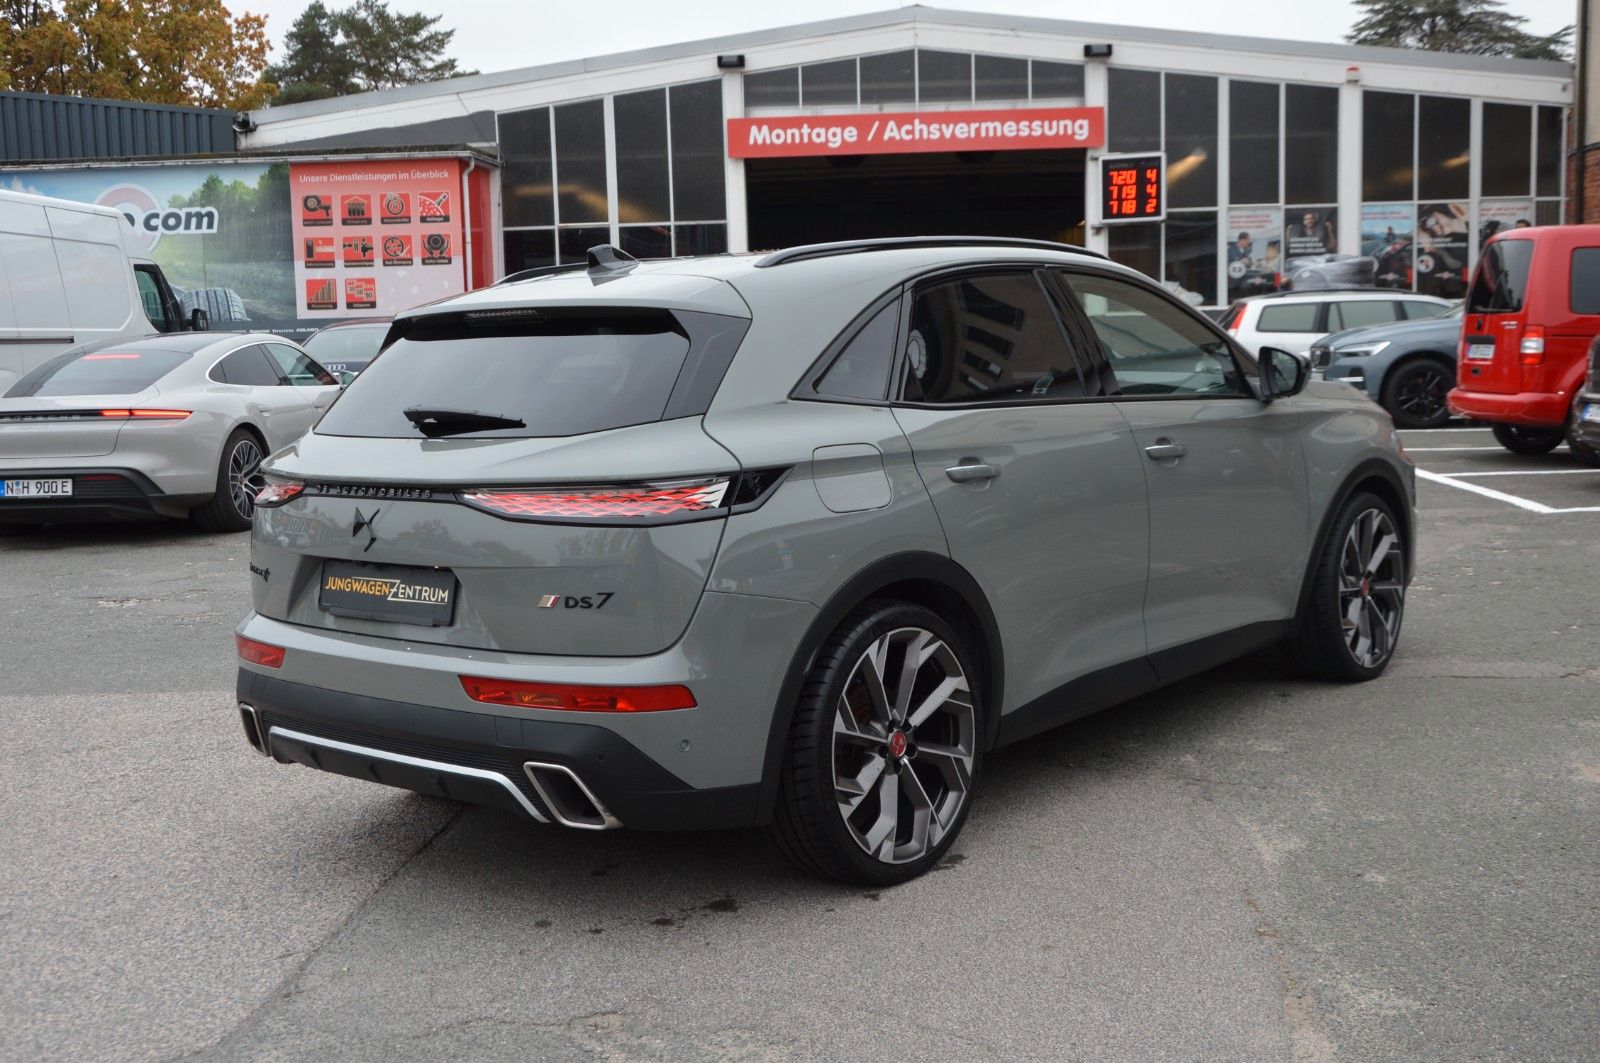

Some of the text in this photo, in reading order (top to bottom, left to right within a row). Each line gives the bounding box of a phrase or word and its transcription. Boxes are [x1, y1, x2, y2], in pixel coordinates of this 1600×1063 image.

[748, 117, 1089, 148] Montage / Achsvermessung
[299, 169, 449, 183] Unsere Dienstleistungen im Überblick
[1146, 168, 1157, 183] 4
[1146, 183, 1157, 198] 4
[1145, 198, 1157, 213] 2
[6, 481, 14, 495] N
[21, 481, 30, 495] H
[35, 480, 58, 494] 900
[564, 595, 593, 609] DS
